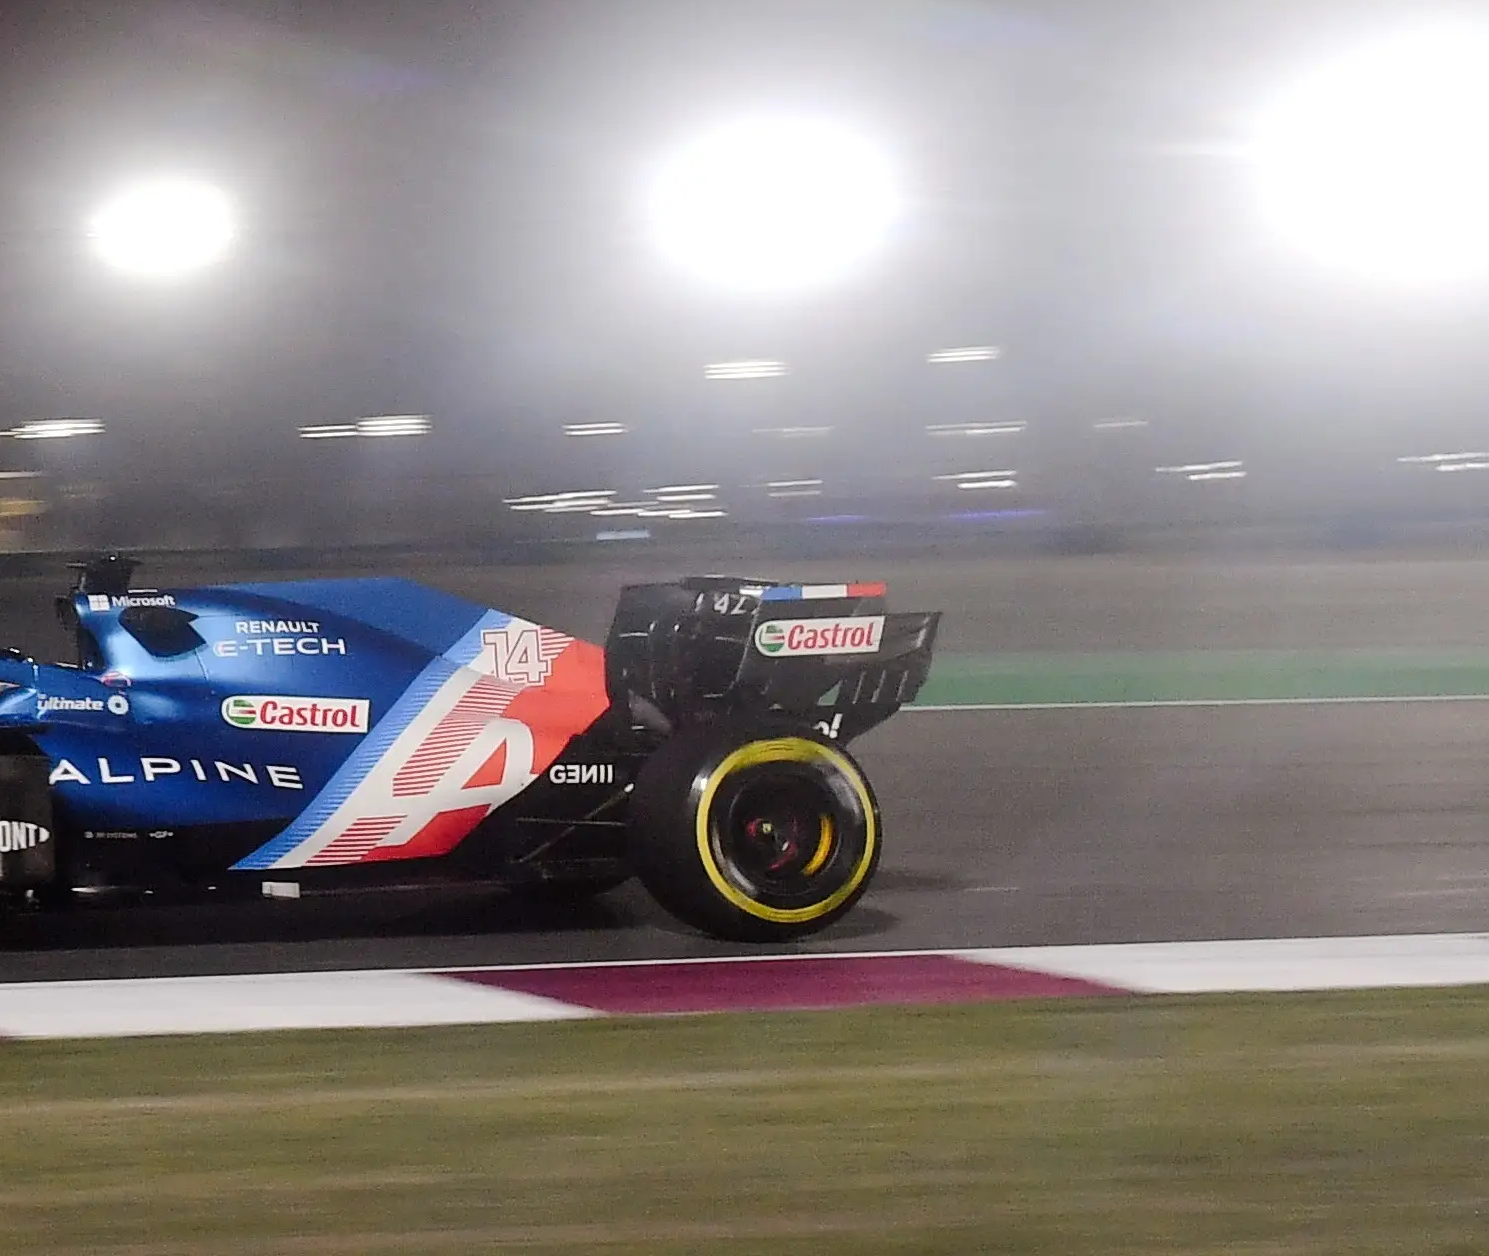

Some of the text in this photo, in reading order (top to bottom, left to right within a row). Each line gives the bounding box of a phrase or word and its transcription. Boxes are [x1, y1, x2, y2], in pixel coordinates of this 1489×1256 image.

[111, 594, 176, 608] Microsoft
[235, 620, 320, 634] RENAULT
[787, 623, 874, 650] Castrol
[212, 637, 347, 657] E-TECH
[480, 628, 552, 686] 14
[259, 700, 361, 728] Castrol
[48, 757, 304, 790] ALPINE
